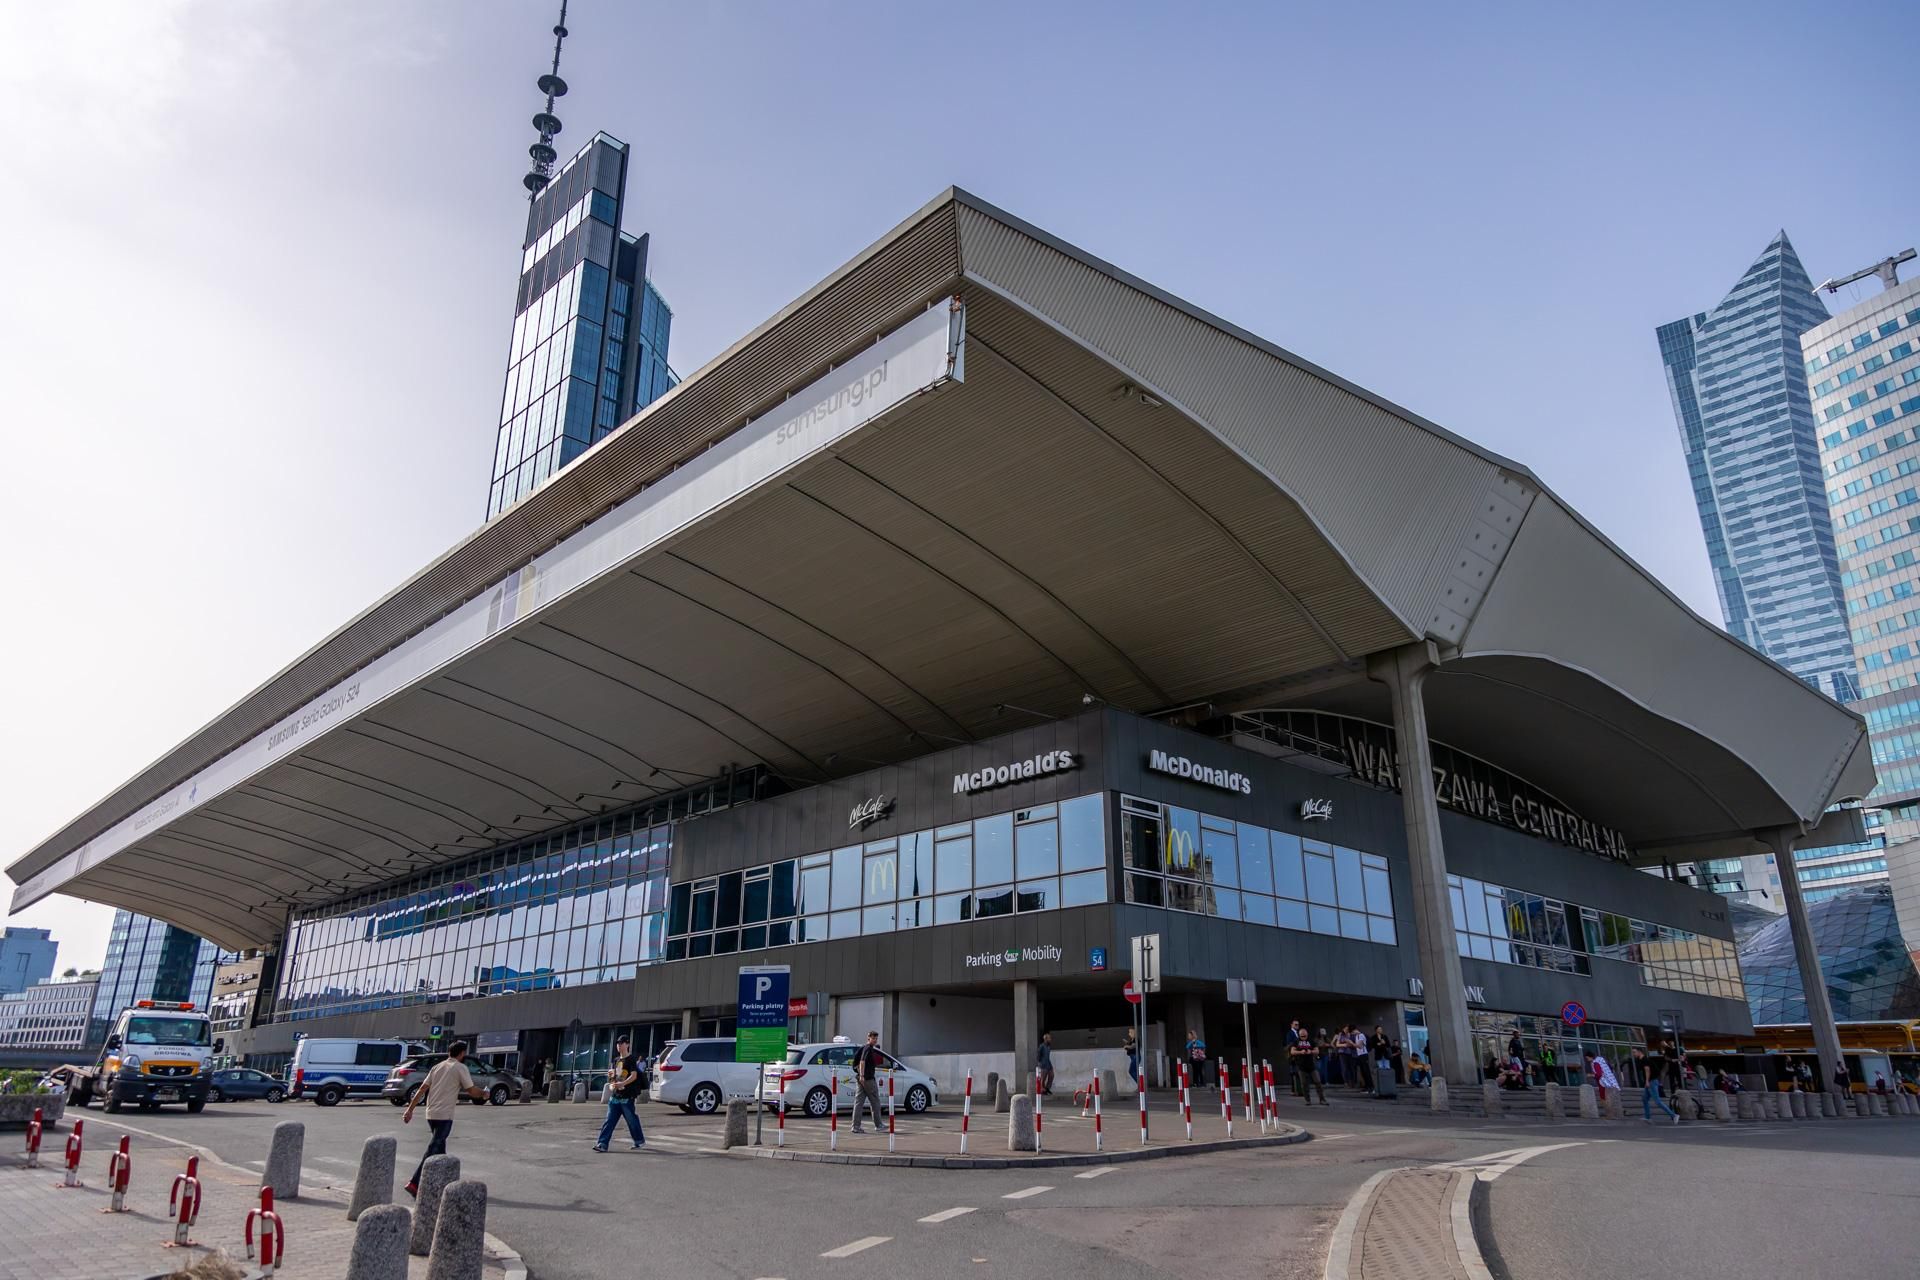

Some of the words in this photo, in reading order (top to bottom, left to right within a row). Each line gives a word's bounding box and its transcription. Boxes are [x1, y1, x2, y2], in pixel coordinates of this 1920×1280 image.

[776, 359, 888, 445] samsung.pl
[267, 720, 300, 751] SAMSUNG
[301, 708, 321, 731] Seria
[320, 694, 347, 719] Galaxy
[346, 683, 360, 704] S24
[953, 750, 1073, 794] McDonald's
[1150, 749, 1251, 795] McDonald's
[1348, 735, 1502, 822] WAZAWA
[1511, 795, 1630, 860] CENTRALNA
[966, 952, 1001, 967] Parking
[1022, 945, 1062, 962] Mobility
[1092, 955, 1103, 966] 54
[755, 976, 772, 1001] P
